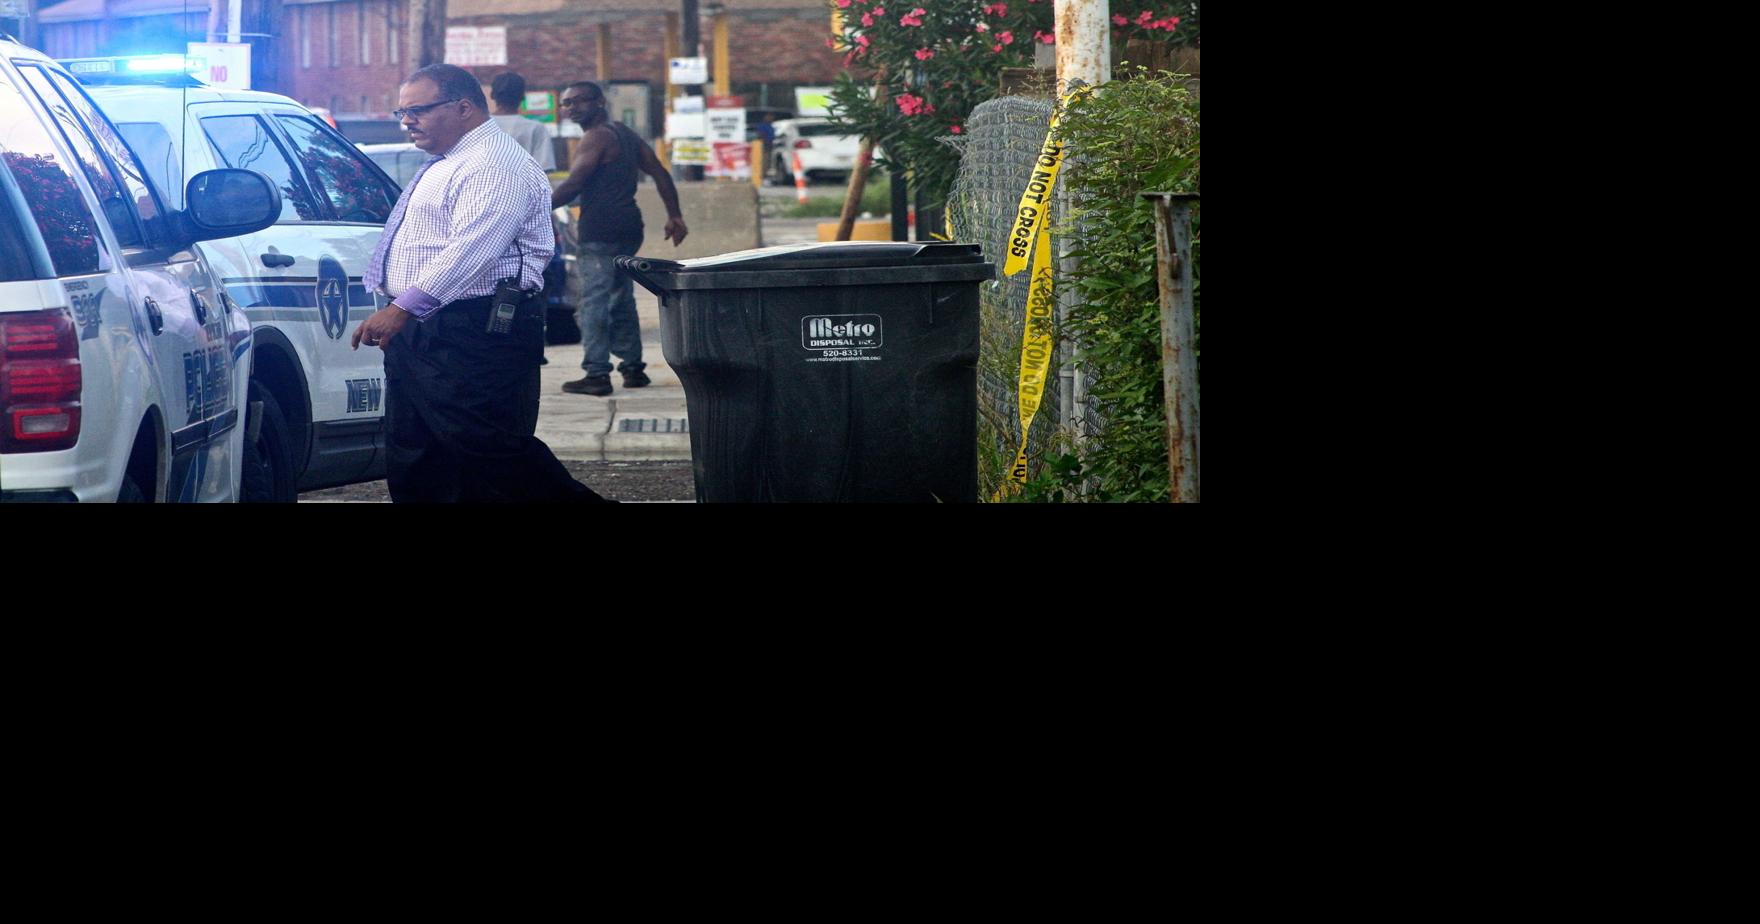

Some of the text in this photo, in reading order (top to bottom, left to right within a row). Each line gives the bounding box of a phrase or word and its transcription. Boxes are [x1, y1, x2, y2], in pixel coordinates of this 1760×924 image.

[210, 66, 227, 82] NO
[1011, 145, 1060, 258] DO NOT CROSS
[809, 318, 875, 337] Metro
[345, 378, 381, 413] NEW
